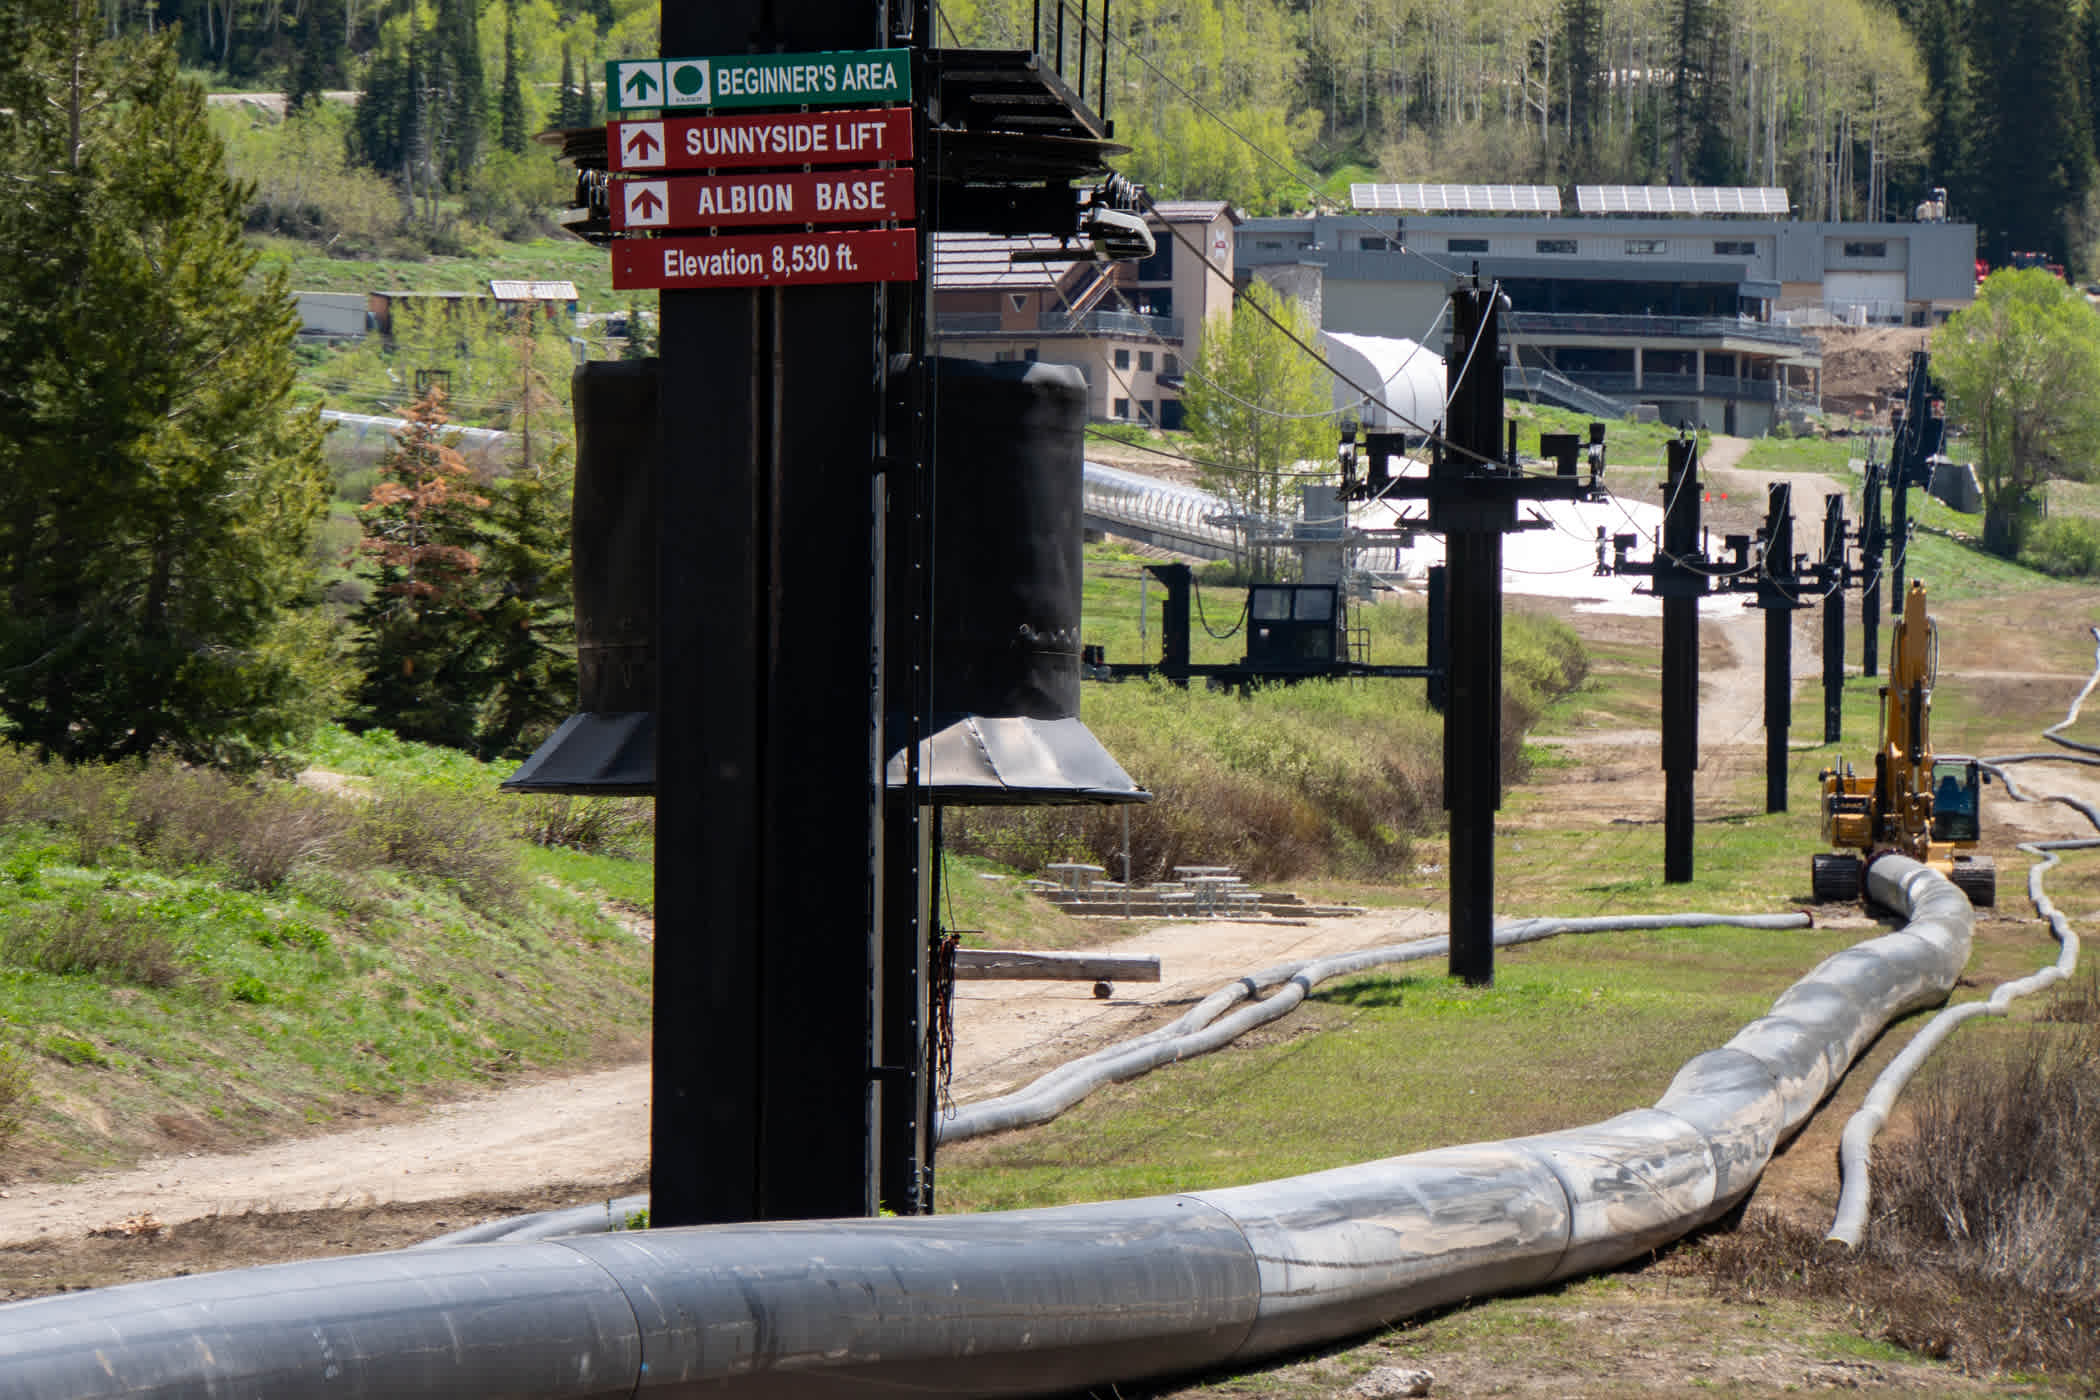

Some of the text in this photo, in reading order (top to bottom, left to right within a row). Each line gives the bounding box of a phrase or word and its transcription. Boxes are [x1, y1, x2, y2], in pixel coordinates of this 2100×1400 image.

[719, 64, 897, 95] BEGINNER'S AREA
[687, 123, 886, 155] SUNNYSIDE LIFT
[699, 182, 885, 214] ALBION BASE
[665, 244, 857, 277] Elevation 8,530 ft.
